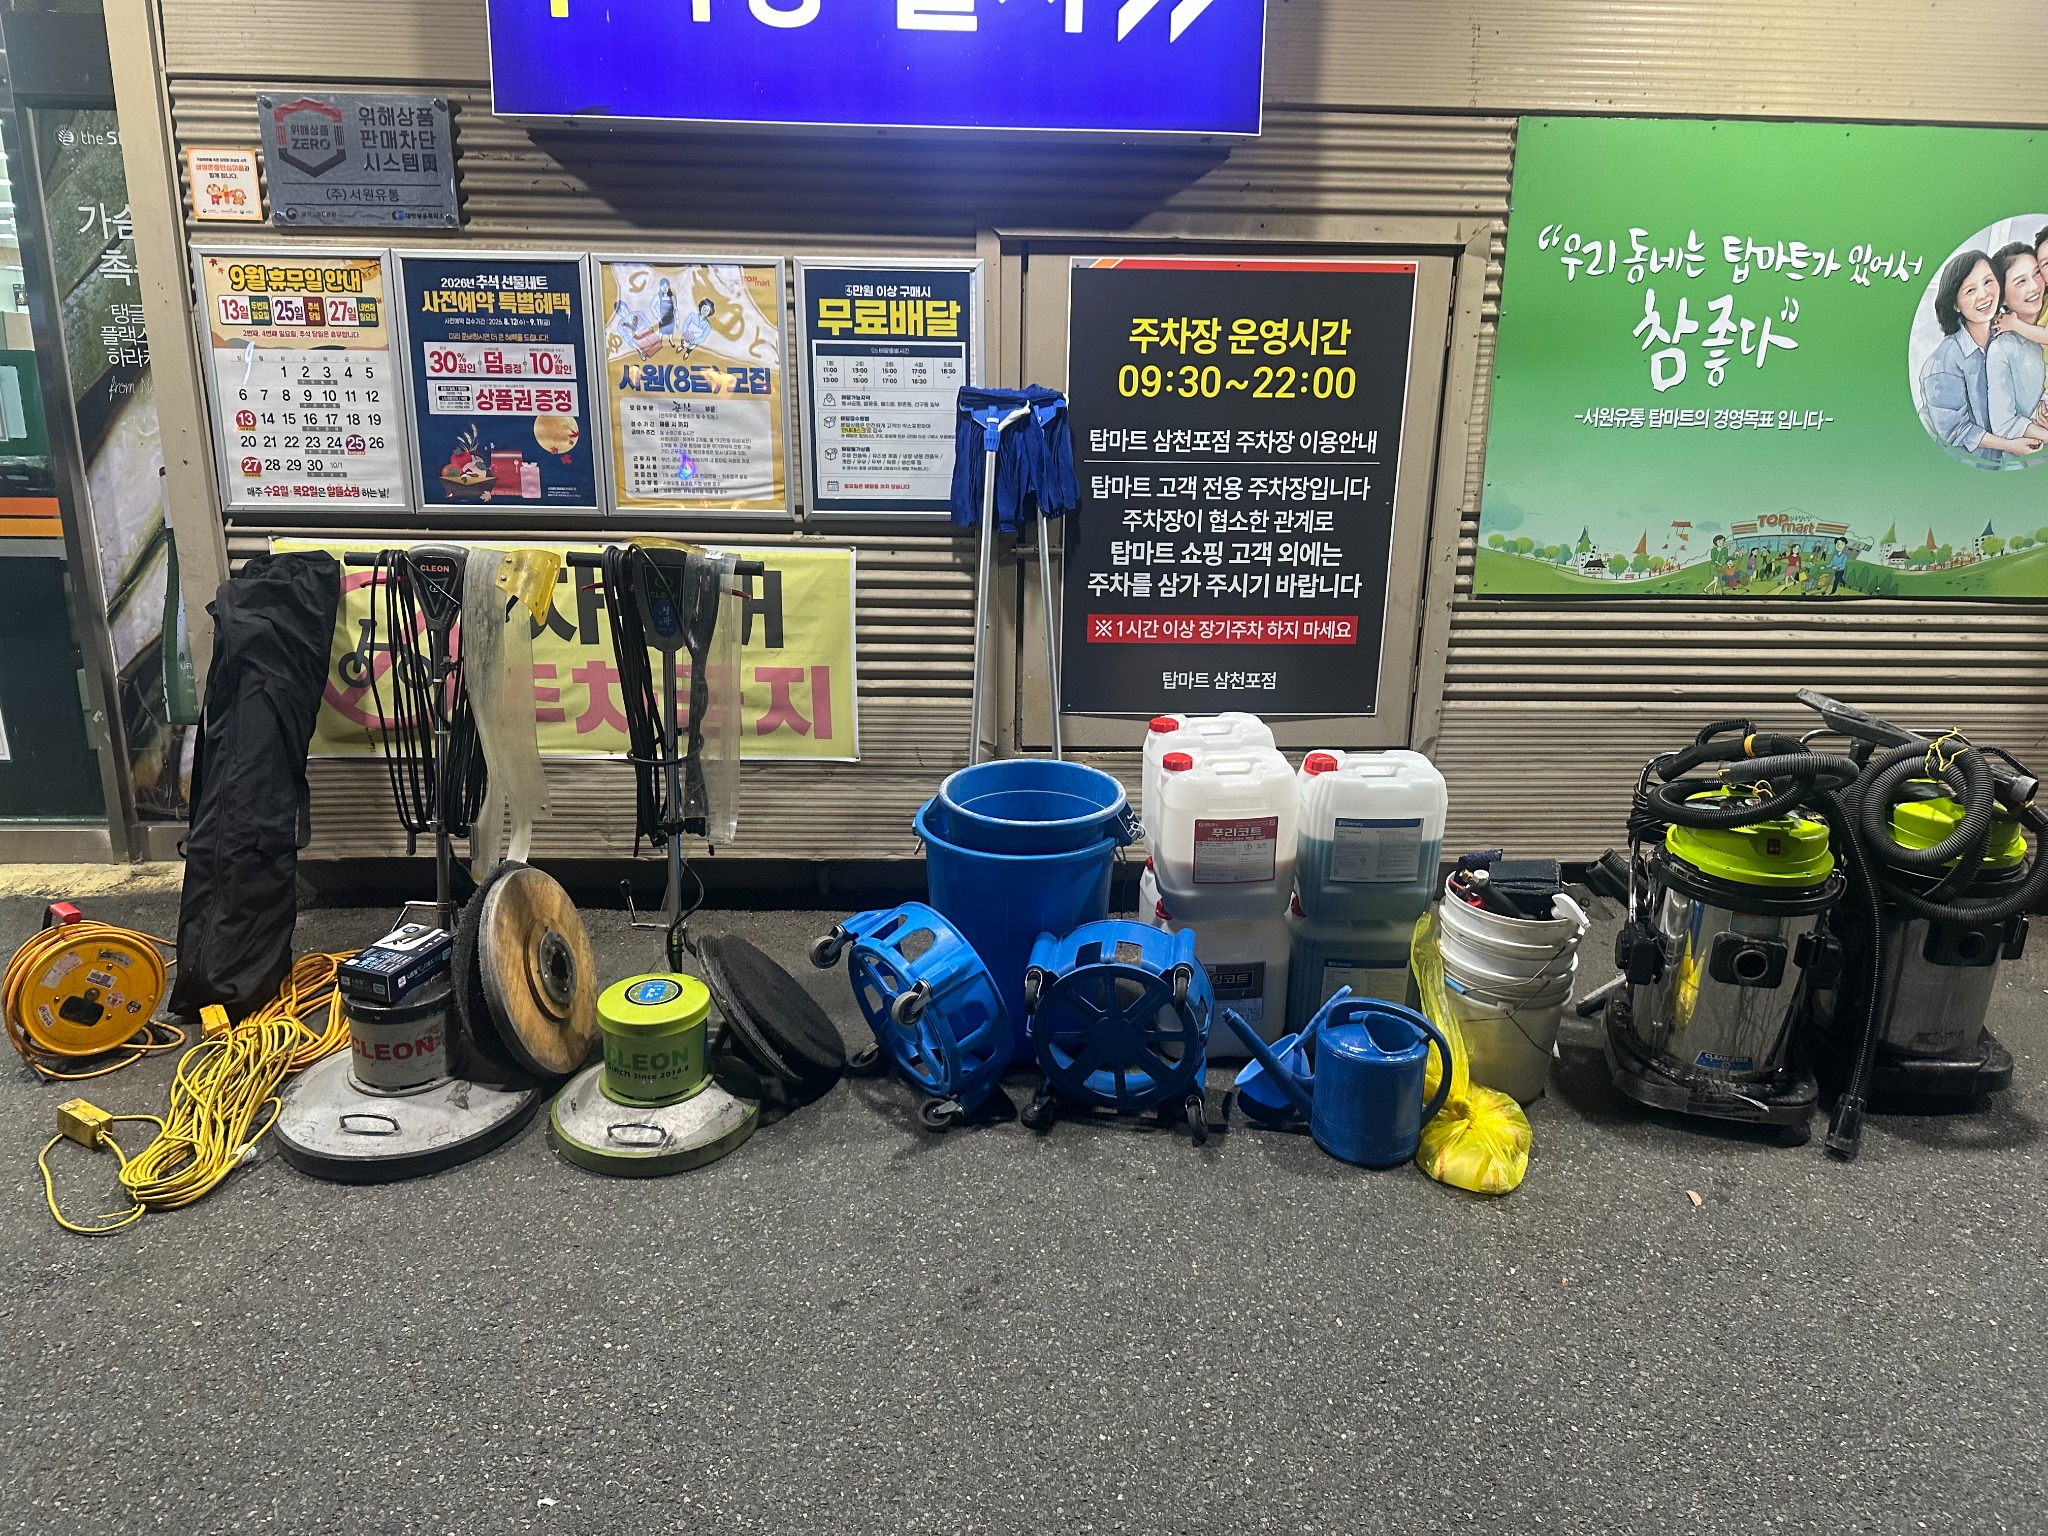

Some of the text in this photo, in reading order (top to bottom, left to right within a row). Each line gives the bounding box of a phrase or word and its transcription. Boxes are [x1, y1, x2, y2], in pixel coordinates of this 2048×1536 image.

[359, 107, 434, 126] 위해상품
[81, 131, 103, 145] the
[290, 125, 329, 135] 위해상품
[360, 130, 436, 149] 판매차단
[292, 139, 330, 150] ZERO
[326, 188, 399, 202] (주) 서원유통
[1623, 227, 1705, 284] 동네는
[1722, 236, 1841, 284] 탑마트가
[1849, 243, 1923, 286] 있어서
[229, 265, 362, 292] 9월 휴무일 안내
[441, 275, 548, 290] 2026년 추석 선물세트
[877, 285, 897, 297] 이상
[900, 286, 930, 297] 구매시
[221, 299, 249, 320] 13일
[275, 300, 304, 320] 25일
[329, 301, 357, 321] 27일
[422, 291, 570, 314] 사전예약 특별혜택
[818, 299, 960, 336] 무료배달
[1129, 317, 1351, 355] 주차장 운영시간
[1633, 288, 1699, 392] 참
[281, 366, 373, 378] 1 2 3 4 5
[458, 364, 475, 373] 할인
[484, 352, 521, 374] 덤 증정
[555, 365, 572, 374] 할인
[1118, 365, 1356, 398] 09:30~22:00
[239, 389, 379, 402] 6 7 8 9 10 11 12
[476, 389, 532, 411] 상품권
[536, 390, 572, 412] 증정
[238, 413, 381, 425] 13 14 15 16 17 18 19
[1649, 408, 1710, 429] 탑마트의
[1714, 409, 1774, 429] 경영목표
[241, 436, 384, 449] 20 21 22 23 24 25 26
[1090, 429, 1377, 454] 탑마트 삼천포점 주차장 이용안내
[243, 459, 259, 471] 27
[265, 460, 280, 470] 28
[286, 460, 301, 470] 29
[307, 460, 323, 471] 30
[362, 488, 377, 497] 하는
[1091, 475, 1370, 501] 탑마트 고객 전용 주차장입니다
[1122, 509, 1334, 533] 주차장이 협소한 관계로
[1110, 540, 1342, 566] 탑마트 쇼핑 고객 외에는
[1088, 572, 1362, 598] 주차를 삼가 주시기 바랍니다
[1162, 620, 1194, 638] 이상
[1199, 620, 1263, 639] 장기주차
[1268, 621, 1298, 639] 하지
[1303, 621, 1351, 639] 마세요
[1162, 672, 1276, 690] 탑마트 삼천포점
[1212, 827, 1261, 837] 푸리코트
[351, 1035, 435, 1061] CLEON
